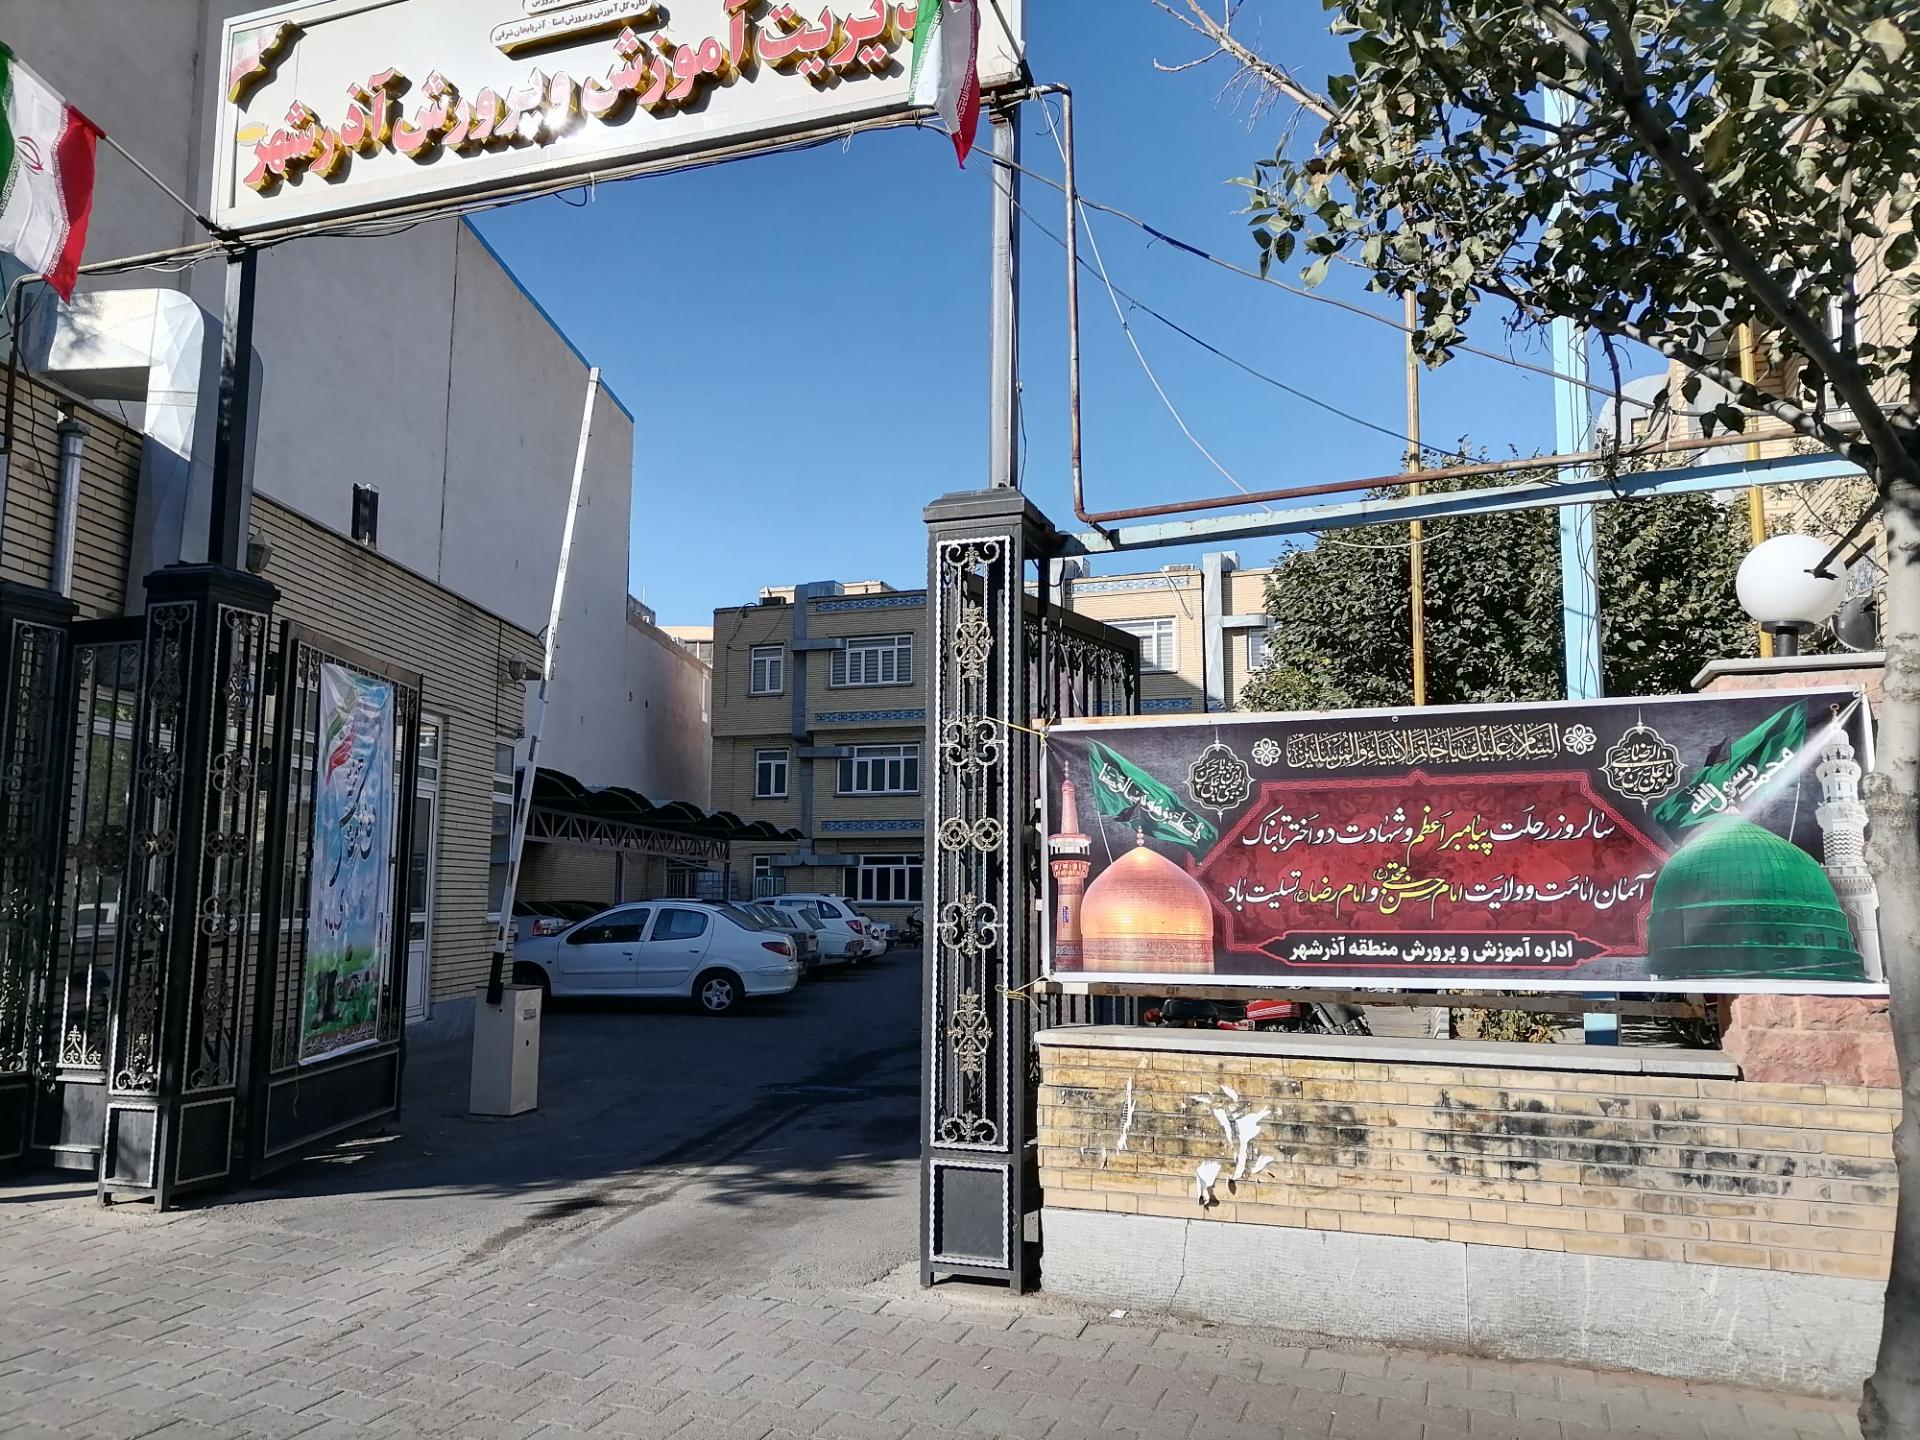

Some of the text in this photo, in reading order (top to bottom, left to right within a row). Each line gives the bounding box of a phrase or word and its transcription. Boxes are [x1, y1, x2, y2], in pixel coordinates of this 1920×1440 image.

[594, 3, 619, 18] آموزش
[392, 67, 545, 150] پرورش
[549, 71, 573, 125] و
[243, 66, 401, 186] آذرشهر
[1737, 746, 1795, 802] محمد
[1242, 804, 1294, 853] تابناک
[1280, 812, 1320, 852] اختر
[1313, 826, 1336, 845] دو
[1336, 806, 1407, 845] شهادت
[1400, 826, 1414, 844] و
[1405, 804, 1454, 869] اعظم
[1436, 812, 1494, 857] پیامبر
[1489, 805, 1552, 842] رحلت
[1224, 876, 1249, 912] باد
[1246, 870, 1302, 910] تسلیت
[1308, 876, 1339, 903] رضا
[1335, 882, 1367, 920] امام
[1368, 884, 1380, 903] و
[1430, 881, 1464, 921] امام
[1464, 874, 1522, 910] ولایت
[1534, 875, 1594, 902] امامت
[1592, 870, 1657, 910] آسمان
[1289, 936, 1574, 964] اداره آموزش و پرورش منطقه آذرشهر
